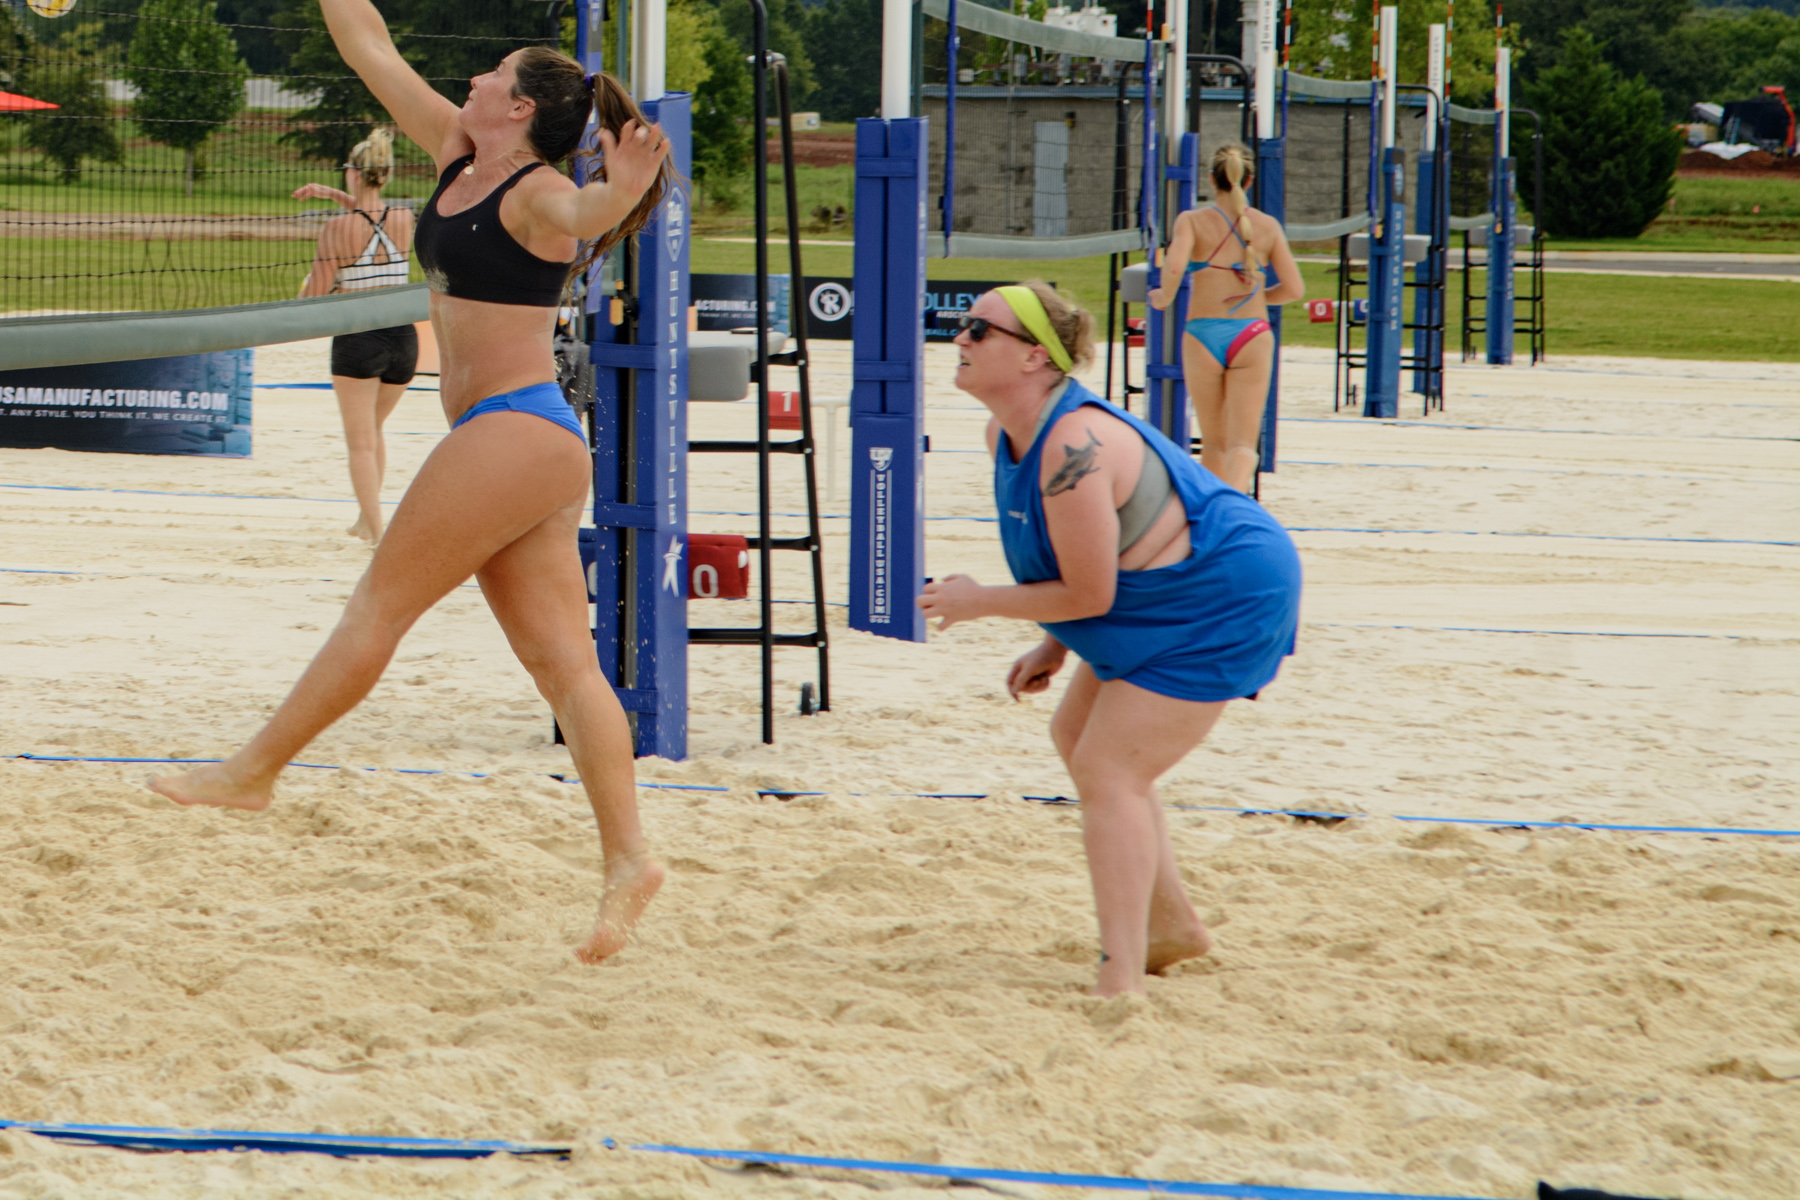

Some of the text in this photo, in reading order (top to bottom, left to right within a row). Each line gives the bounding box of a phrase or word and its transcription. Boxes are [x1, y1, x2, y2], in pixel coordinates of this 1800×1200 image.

[667, 270, 679, 525] HUNTSVILLE
[782, 392, 792, 412] 1
[9, 408, 33, 417] ANY
[34, 409, 71, 419] STYLE.
[73, 410, 97, 419] YOU
[99, 411, 133, 420] THINK
[152, 412, 170, 421] WE
[172, 413, 213, 423] CREATE
[693, 564, 719, 598] 0
